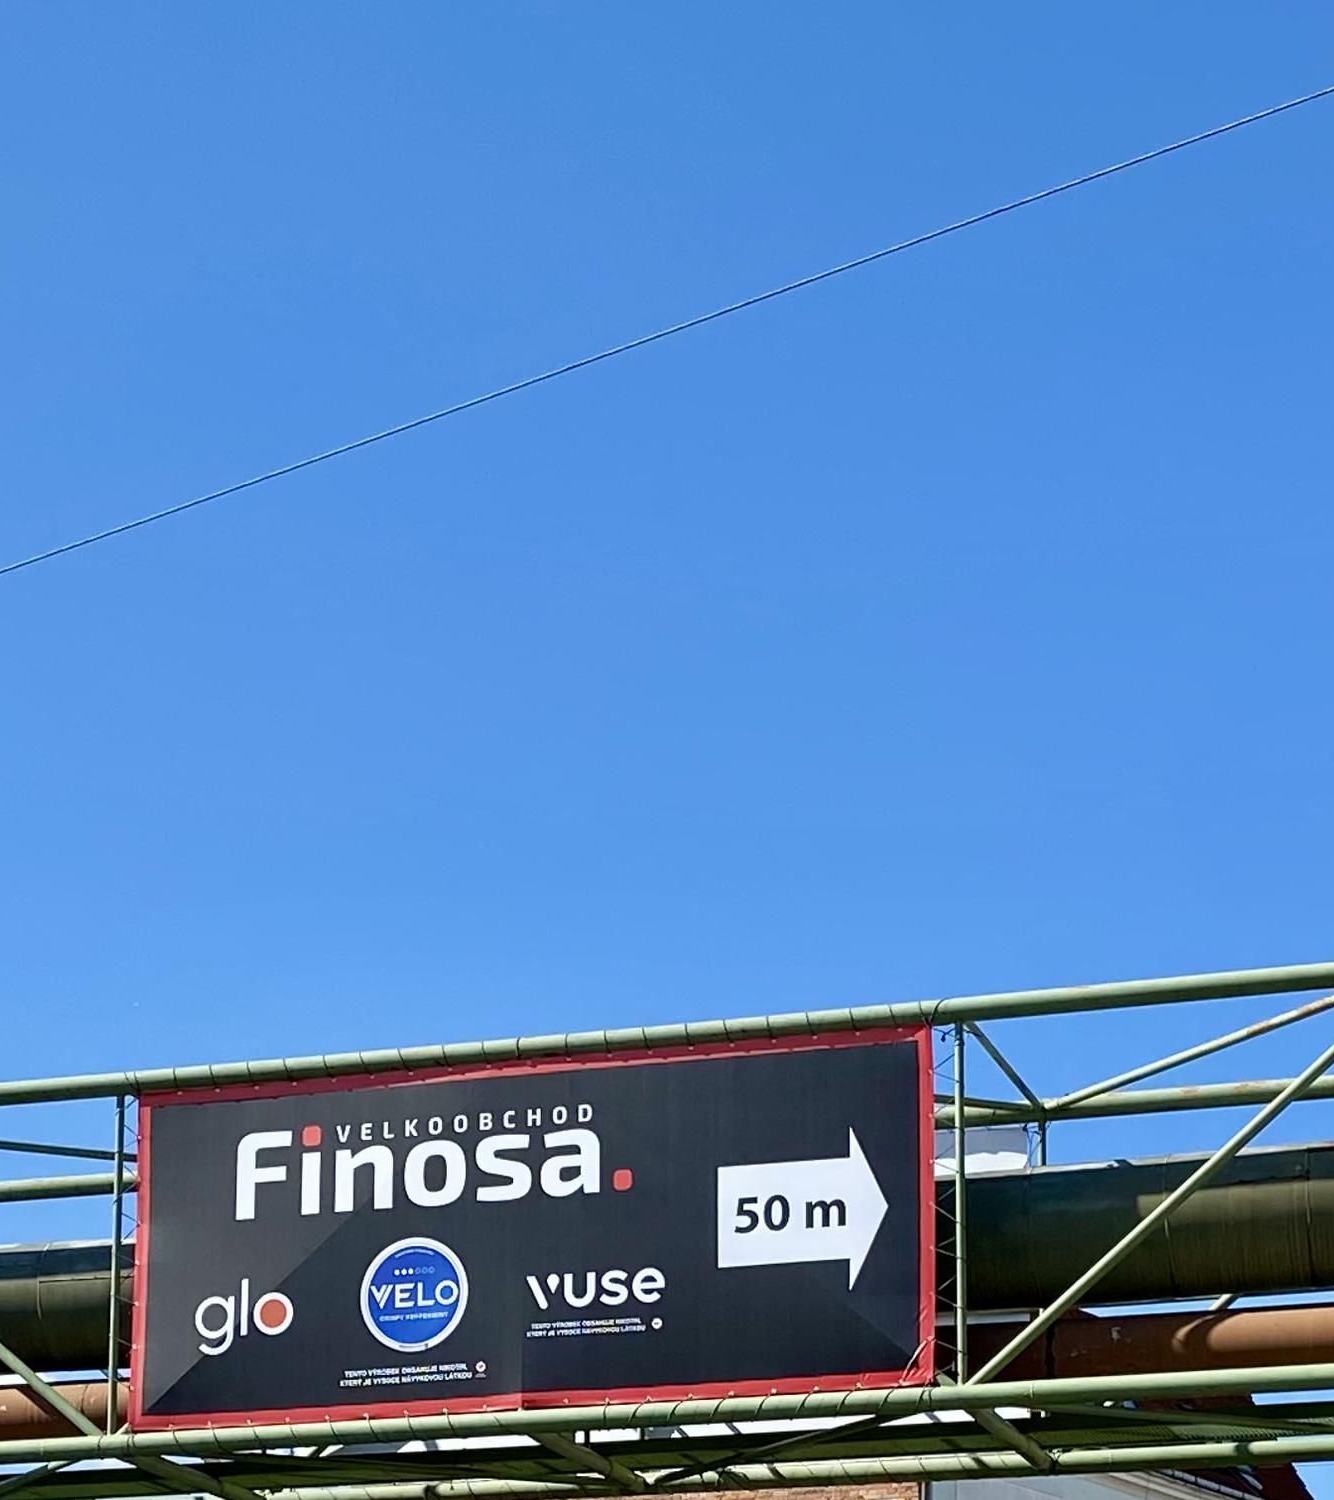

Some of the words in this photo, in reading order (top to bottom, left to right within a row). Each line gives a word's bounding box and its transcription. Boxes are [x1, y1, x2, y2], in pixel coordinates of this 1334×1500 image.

[335, 1103, 594, 1143] VELKOOBCHOD
[734, 1194, 790, 1234] 50
[805, 1199, 847, 1229] m
[370, 1279, 459, 1309] VELO
[194, 1278, 294, 1356] glo
